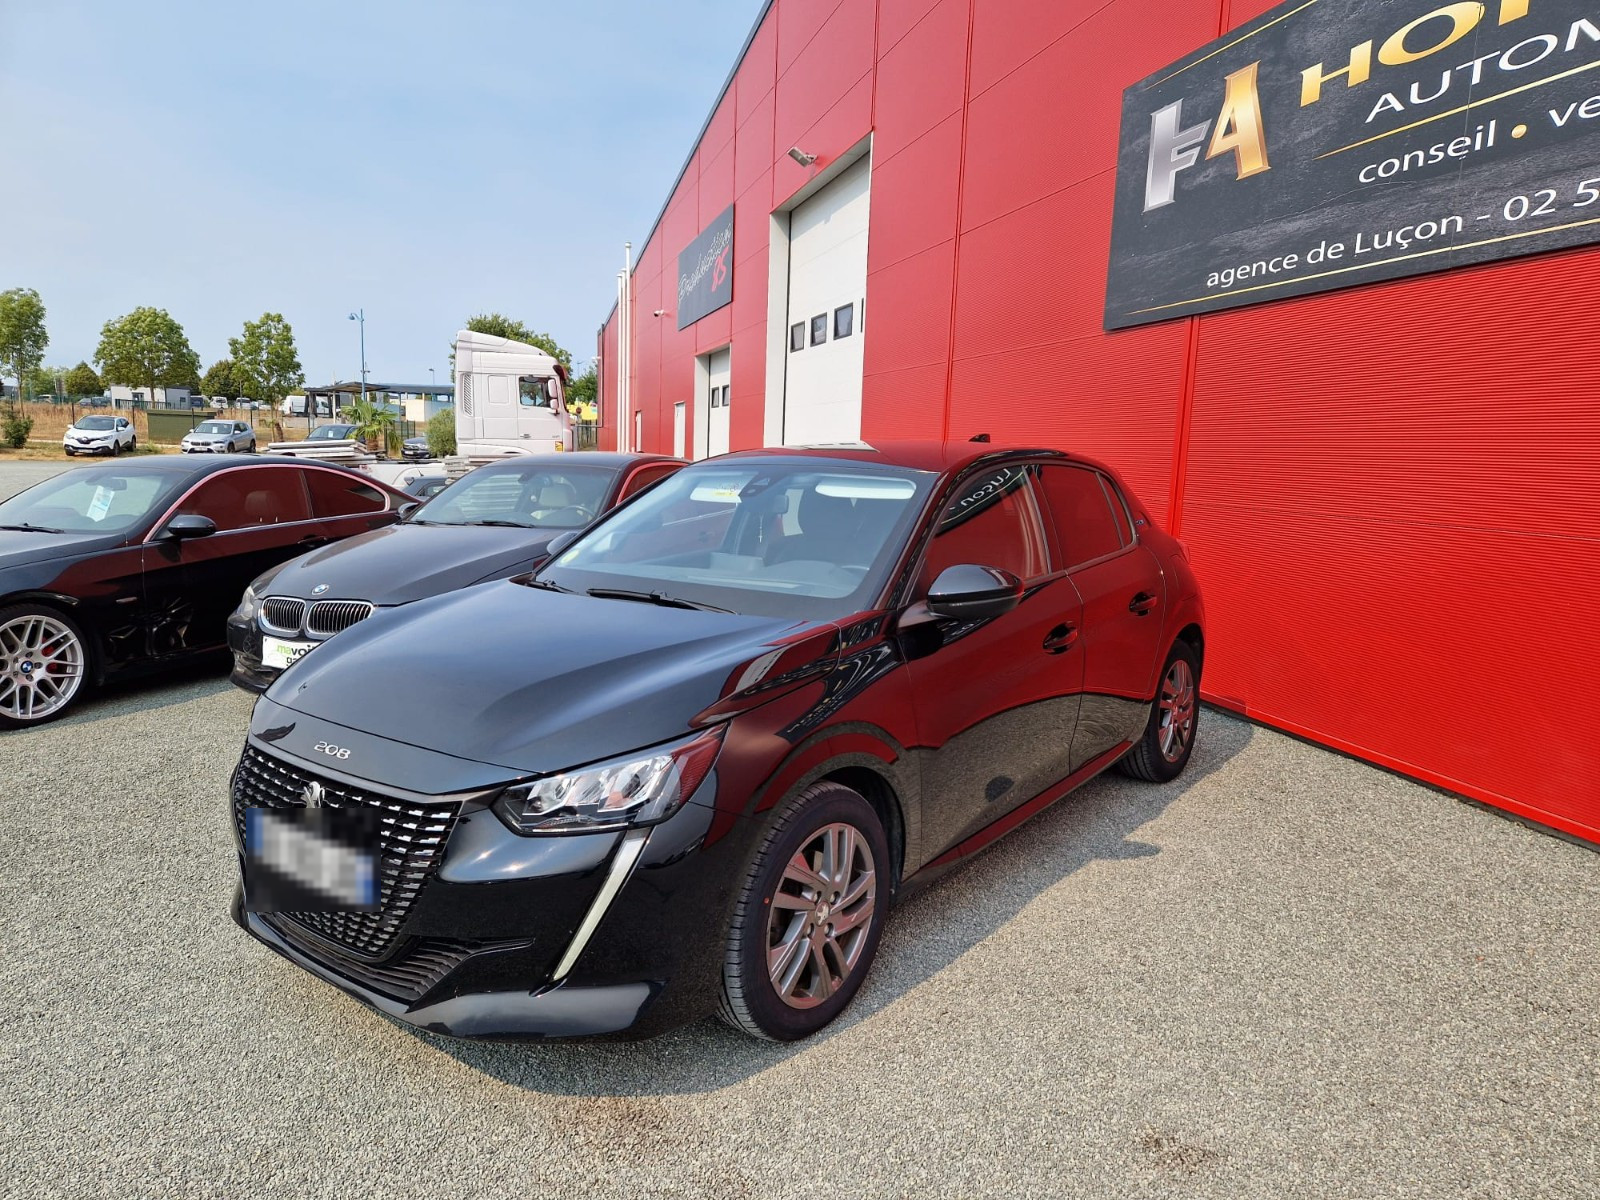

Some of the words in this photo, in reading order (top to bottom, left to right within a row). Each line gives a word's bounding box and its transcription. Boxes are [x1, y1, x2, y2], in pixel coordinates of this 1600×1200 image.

[1358, 119, 1497, 183] conseil
[1206, 253, 1298, 288] agence
[1306, 241, 1345, 264] de
[1355, 215, 1463, 254] Luçon
[1503, 189, 1557, 221] 02
[1572, 177, 1600, 207] 5
[277, 644, 316, 656] mavo
[314, 741, 351, 760] 208
